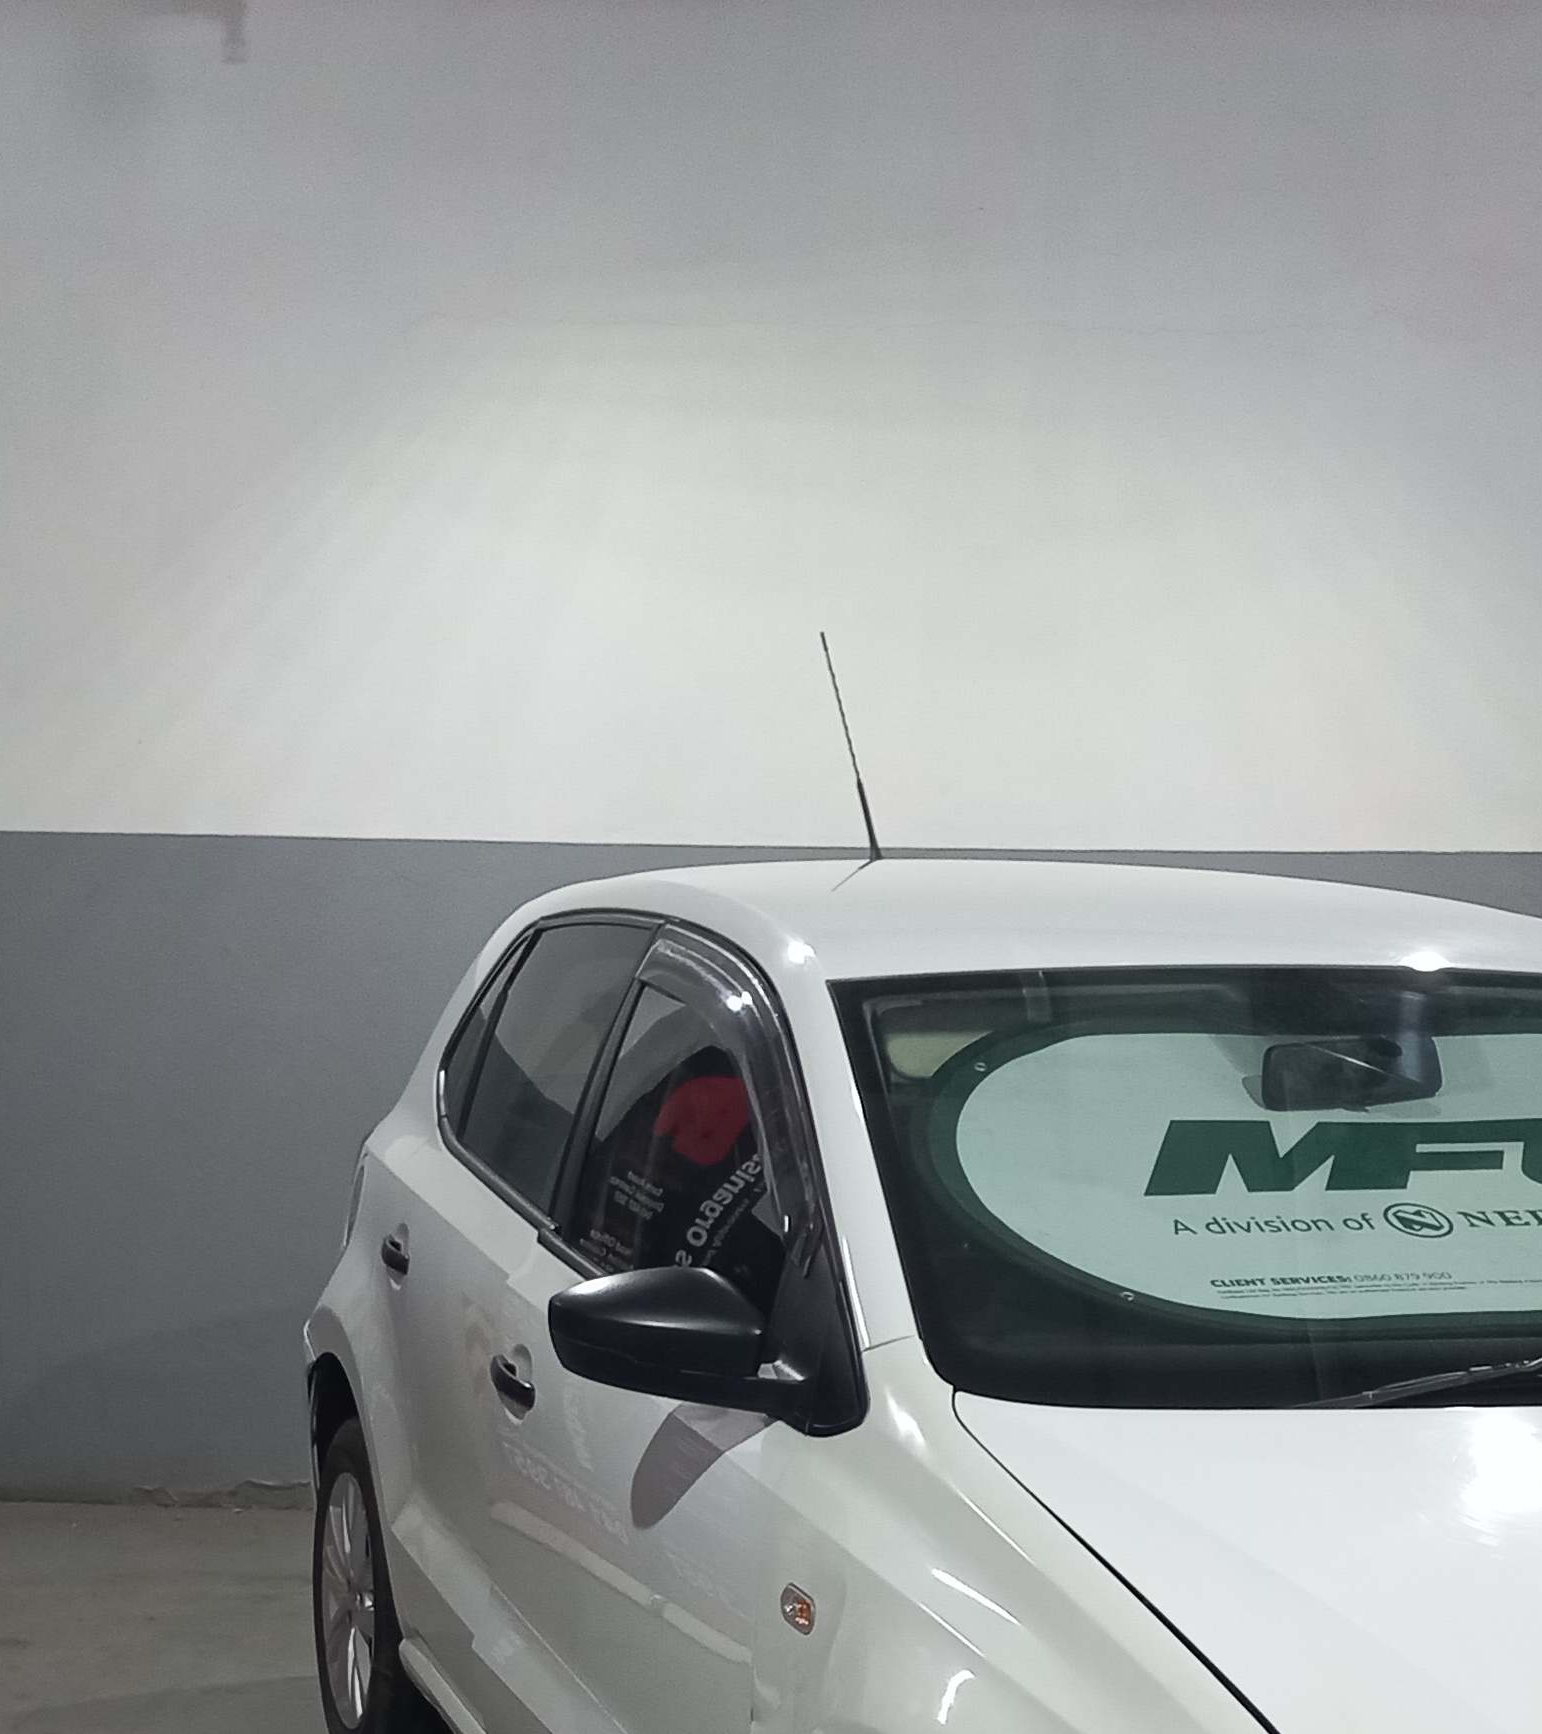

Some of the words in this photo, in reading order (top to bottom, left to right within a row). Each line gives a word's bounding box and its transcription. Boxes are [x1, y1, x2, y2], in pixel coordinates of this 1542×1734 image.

[1173, 1217, 1197, 1236] A
[1205, 1214, 1334, 1237] division
[1343, 1211, 1376, 1230] of
[1210, 1277, 1266, 1288] CLIENT
